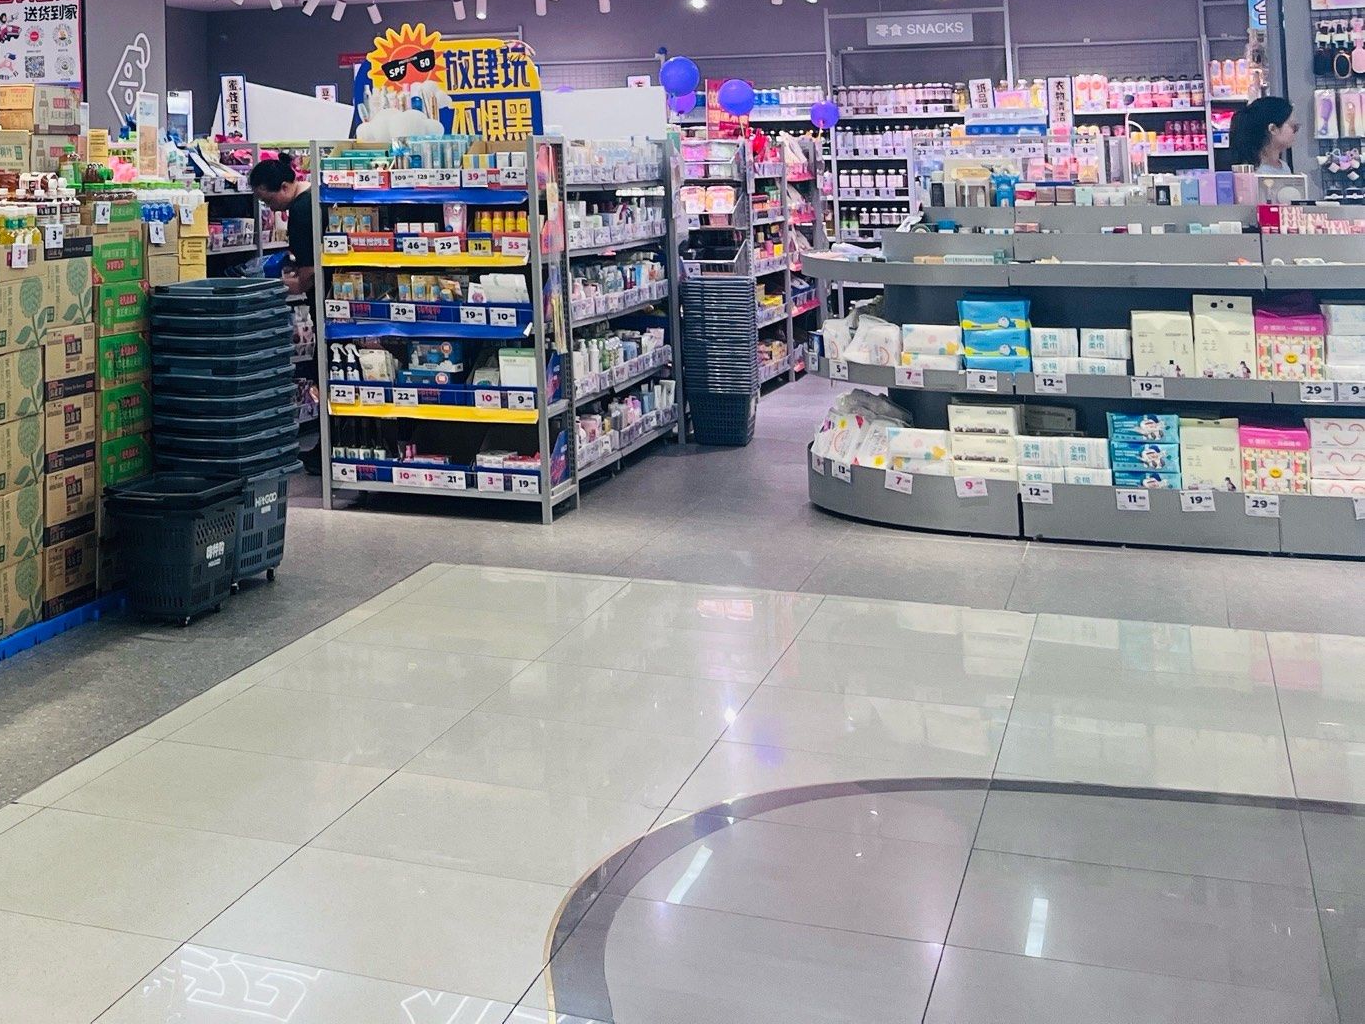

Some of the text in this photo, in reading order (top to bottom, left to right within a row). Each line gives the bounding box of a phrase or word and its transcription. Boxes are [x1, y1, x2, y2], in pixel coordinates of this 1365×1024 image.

[24, 4, 77, 22] 送货到家
[907, 22, 964, 35] SNACKS
[389, 65, 405, 77] SPF
[420, 57, 431, 68] 50
[443, 47, 530, 90] 放肆玩
[451, 99, 532, 142] 不惧黑
